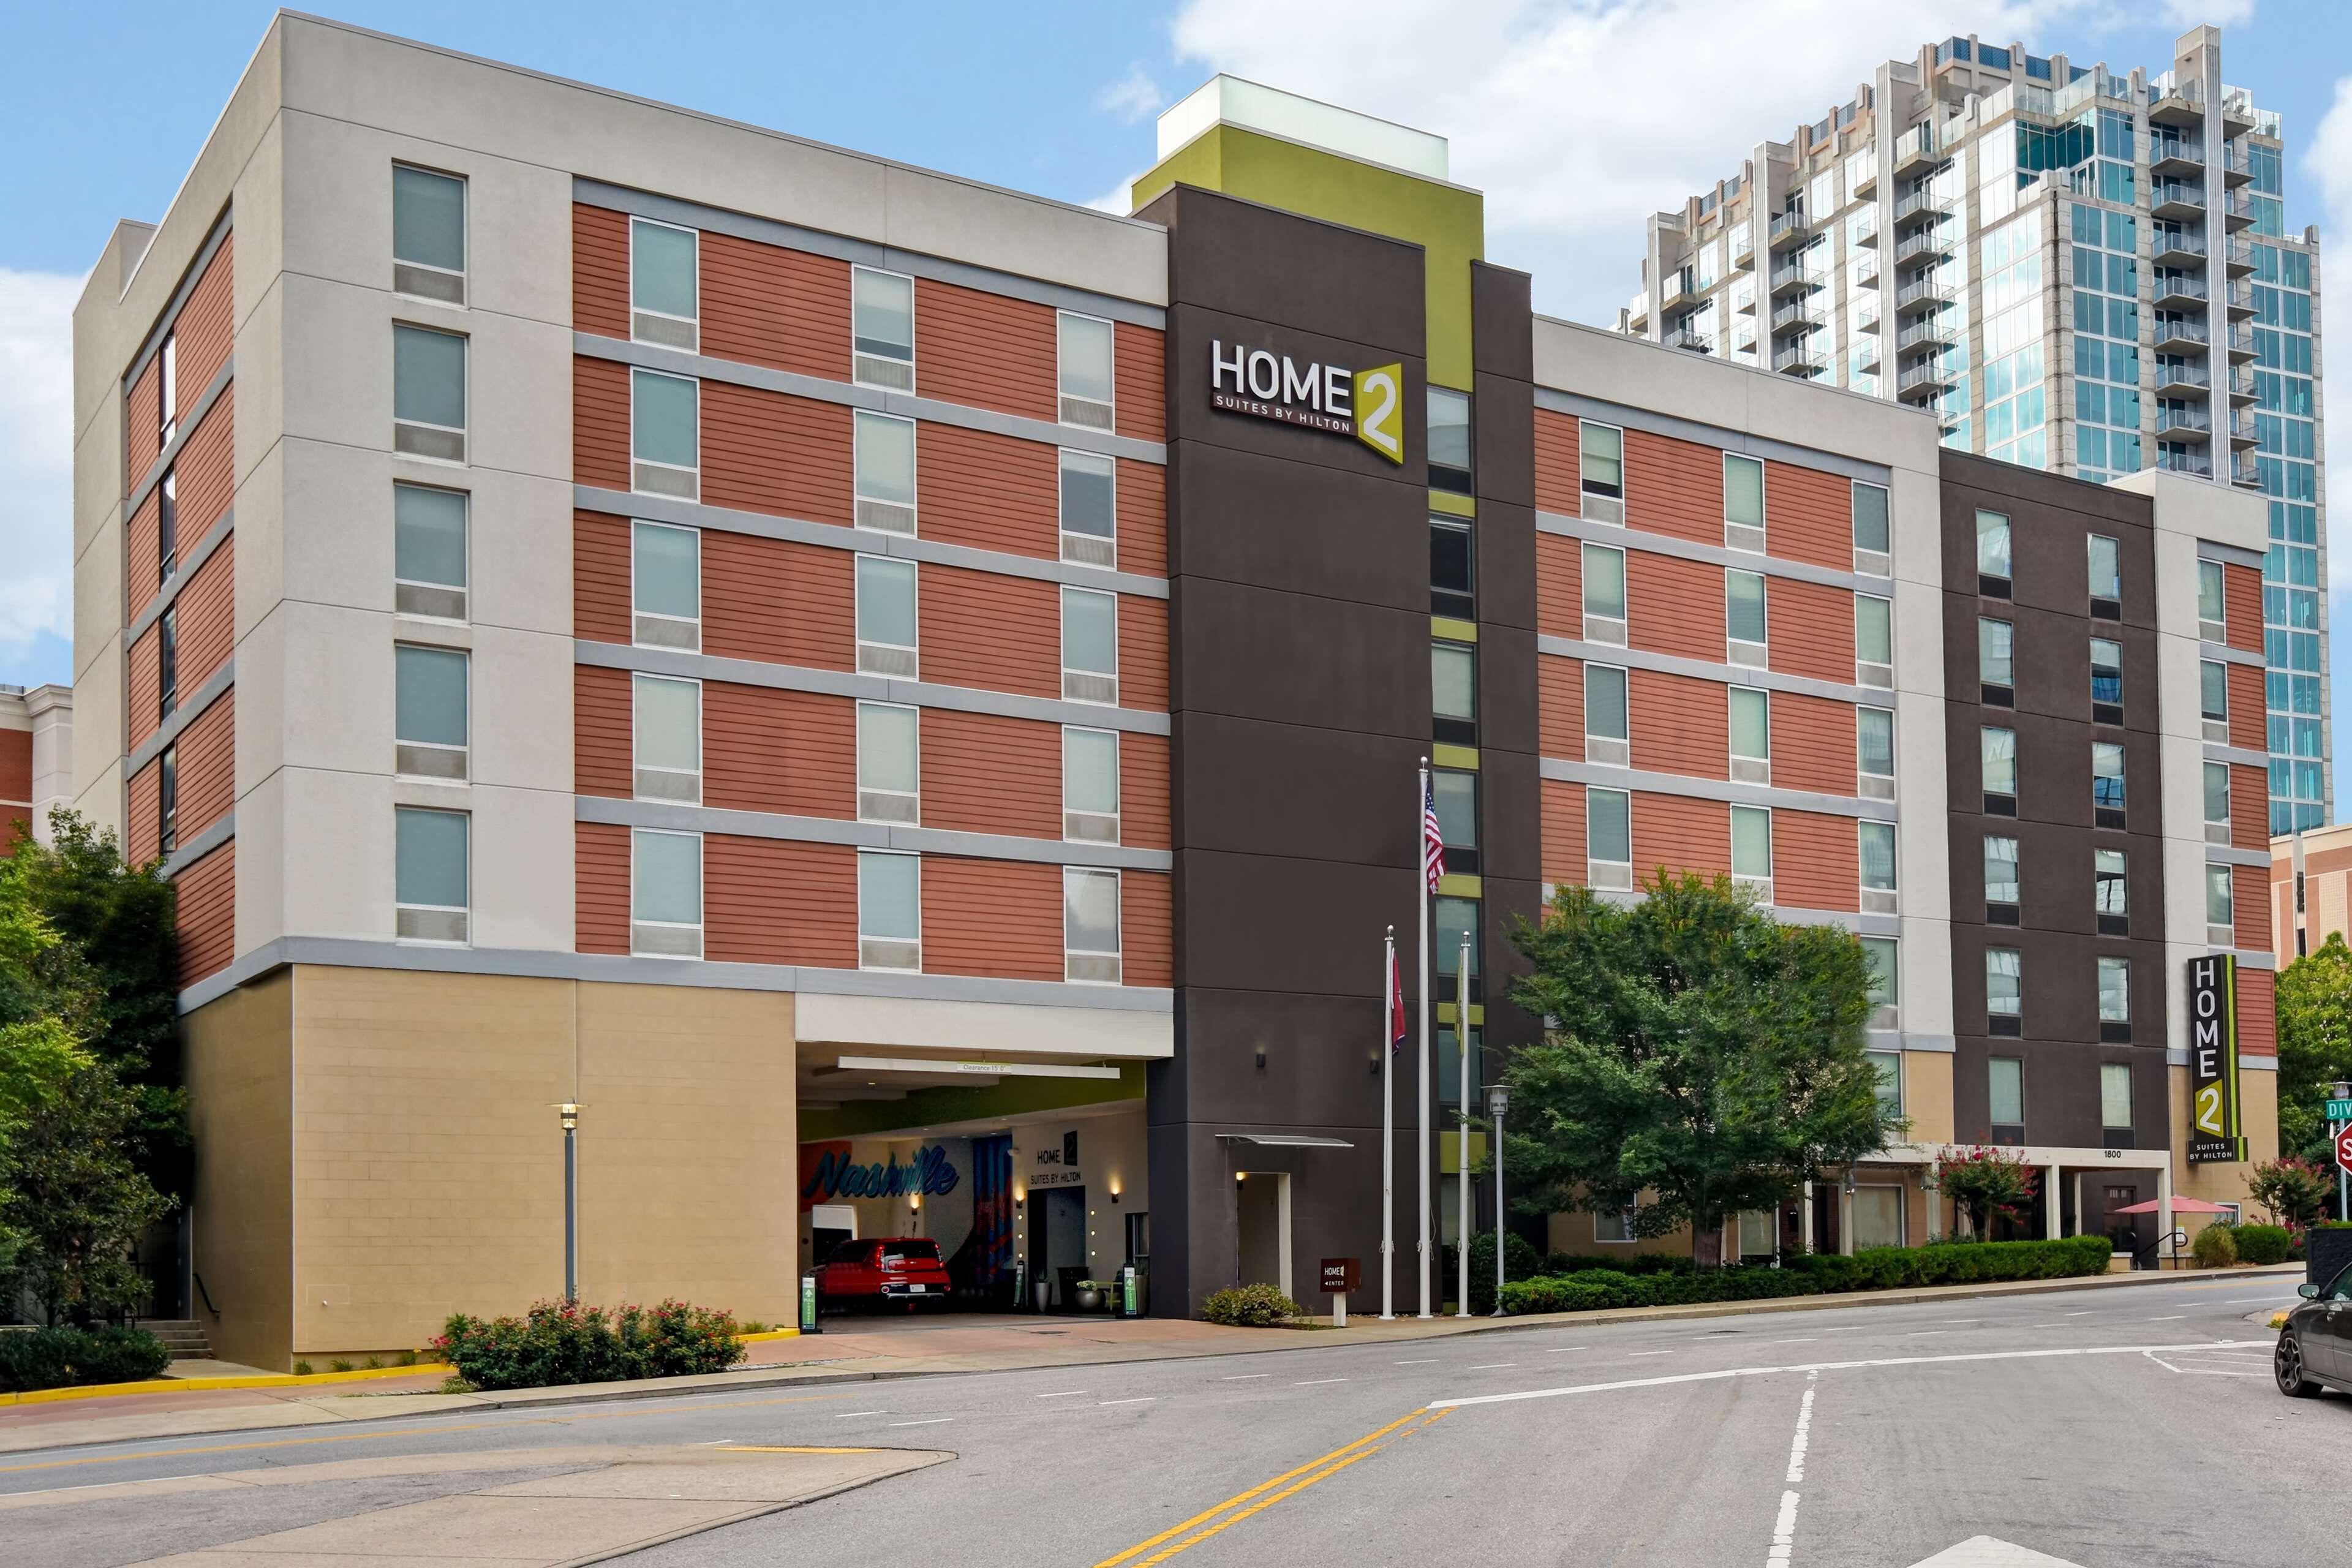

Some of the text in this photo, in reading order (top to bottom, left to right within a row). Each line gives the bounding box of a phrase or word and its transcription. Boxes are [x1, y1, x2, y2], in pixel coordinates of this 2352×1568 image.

[1213, 339, 1397, 453] HOME 2
[1216, 396, 1349, 432] SUITES BY HILTON
[2196, 959, 2220, 1131] HOME 2
[802, 1145, 960, 1198] Nashville
[1031, 1172, 1080, 1185] SUITES BY HILTON
[1037, 1149, 1060, 1164] HOME
